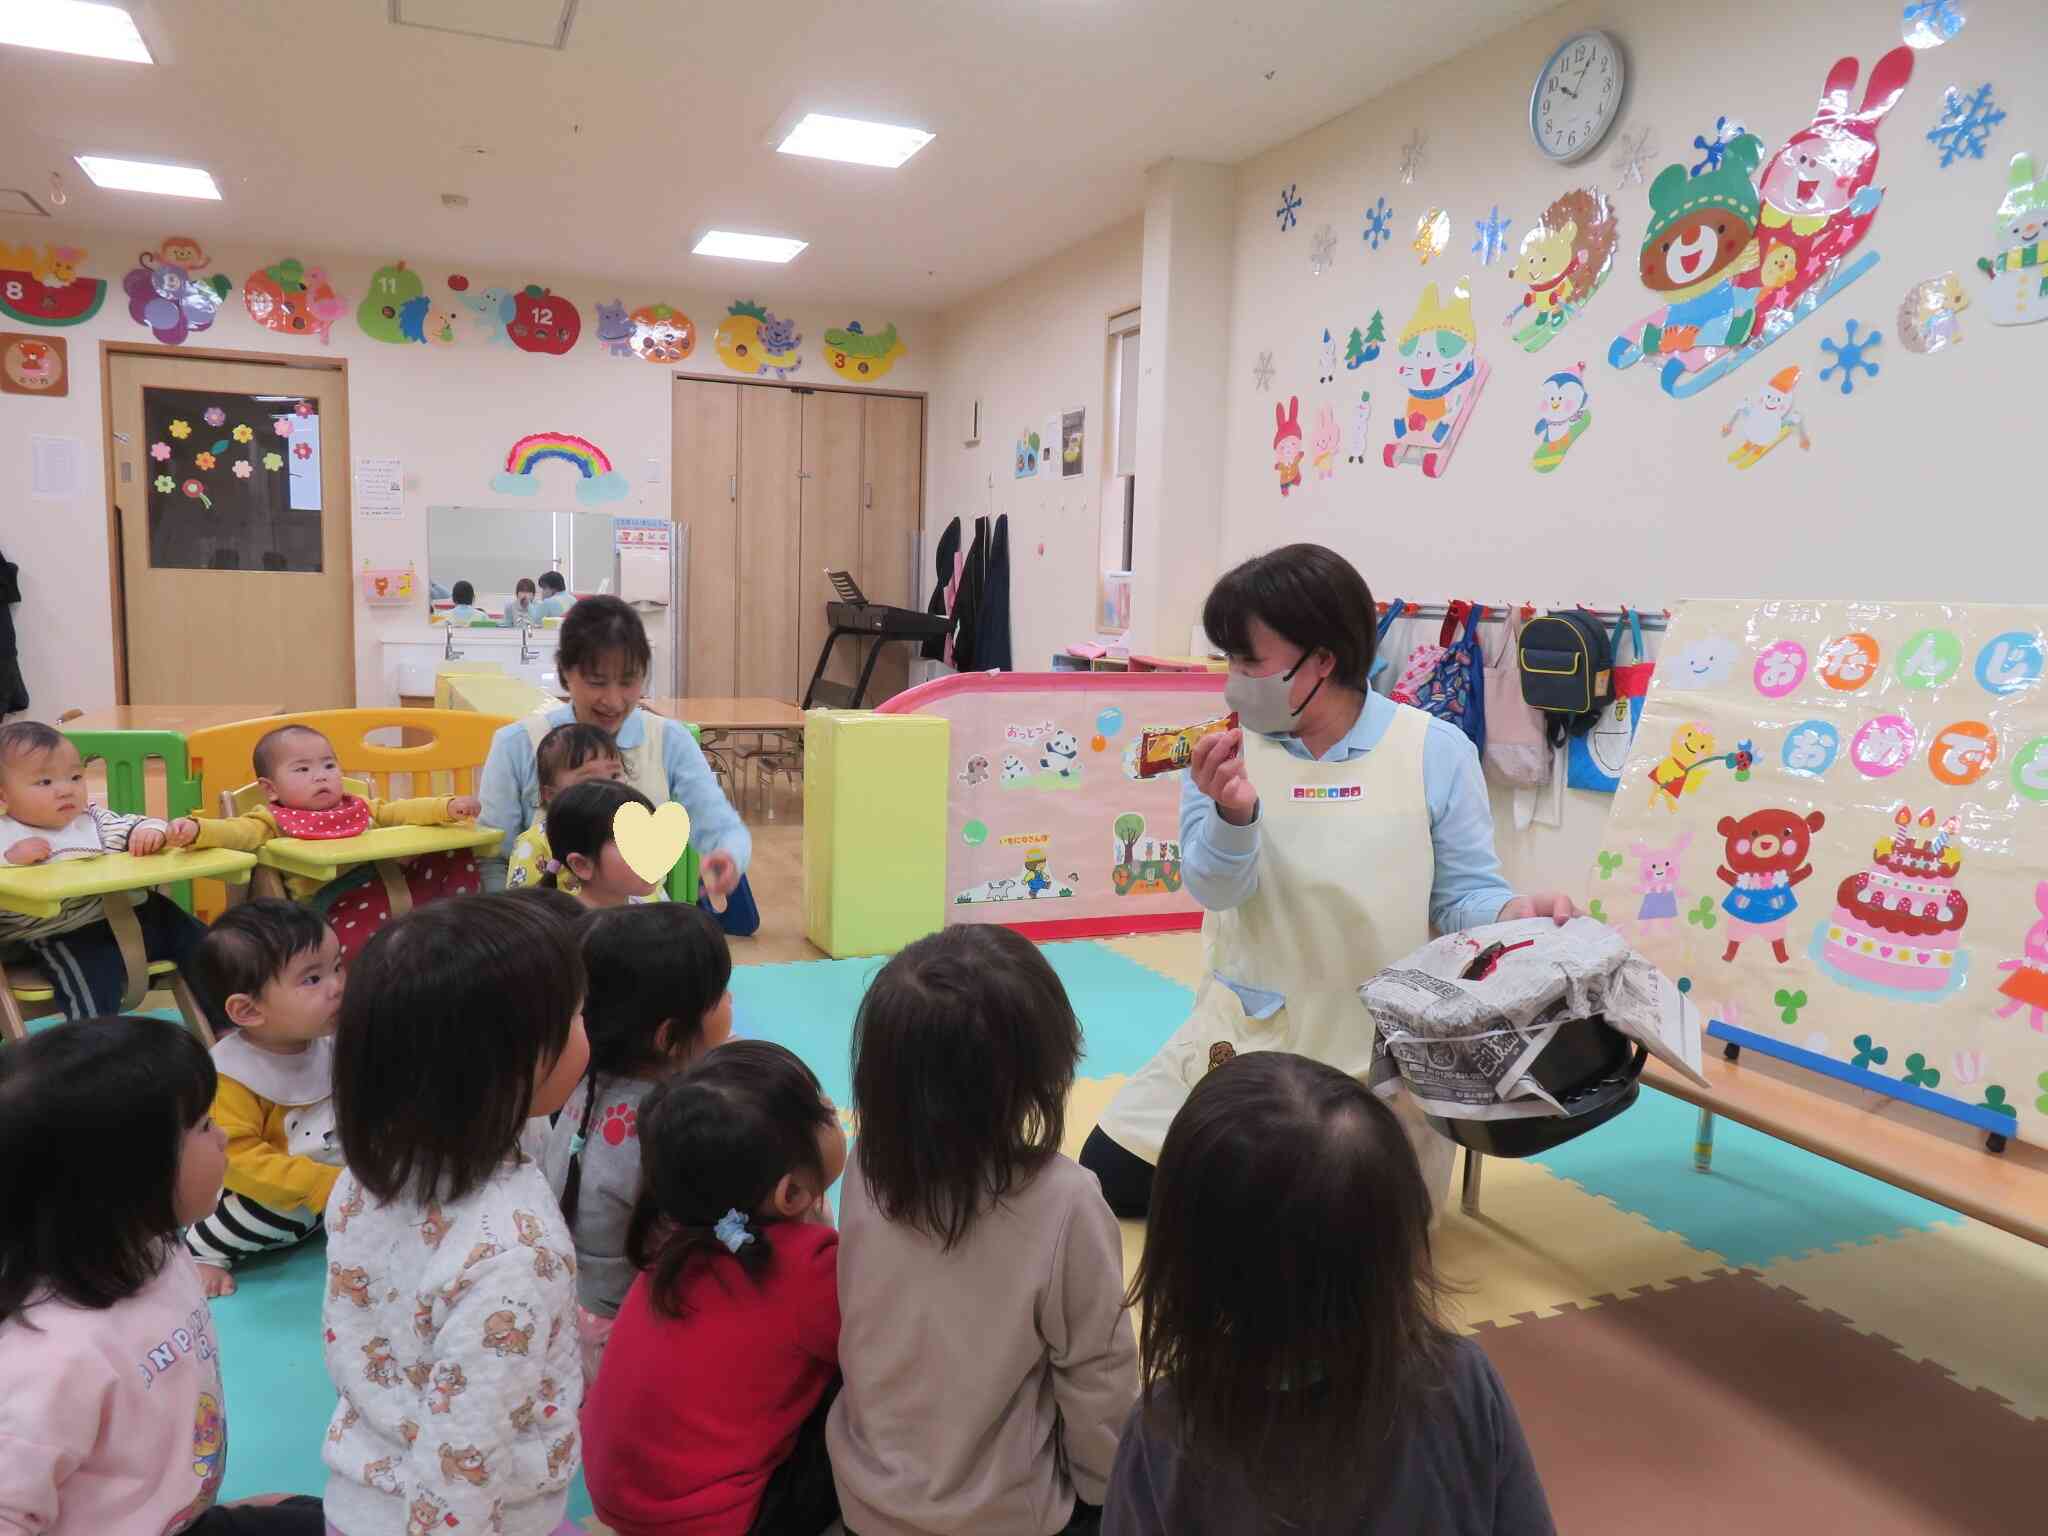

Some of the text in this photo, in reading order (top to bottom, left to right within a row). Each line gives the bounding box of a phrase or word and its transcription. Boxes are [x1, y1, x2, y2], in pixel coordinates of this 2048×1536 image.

[1574, 44, 1586, 63] 12
[1591, 44, 1597, 61] 1
[1560, 56, 1569, 73] 11
[1601, 55, 1609, 73] 2
[1548, 75, 1560, 93] 10
[1603, 76, 1613, 94] 3
[1542, 98, 1551, 116] 9
[1544, 119, 1553, 136] 8
[1583, 120, 1592, 137] 5
[1555, 129, 1564, 146] 7
[1567, 129, 1577, 147] 6
[6, 280, 24, 300] 8
[378, 277, 396, 294] 11
[531, 307, 553, 326] 12
[834, 352, 846, 369] 3
[1008, 721, 1052, 739] おっとっと
